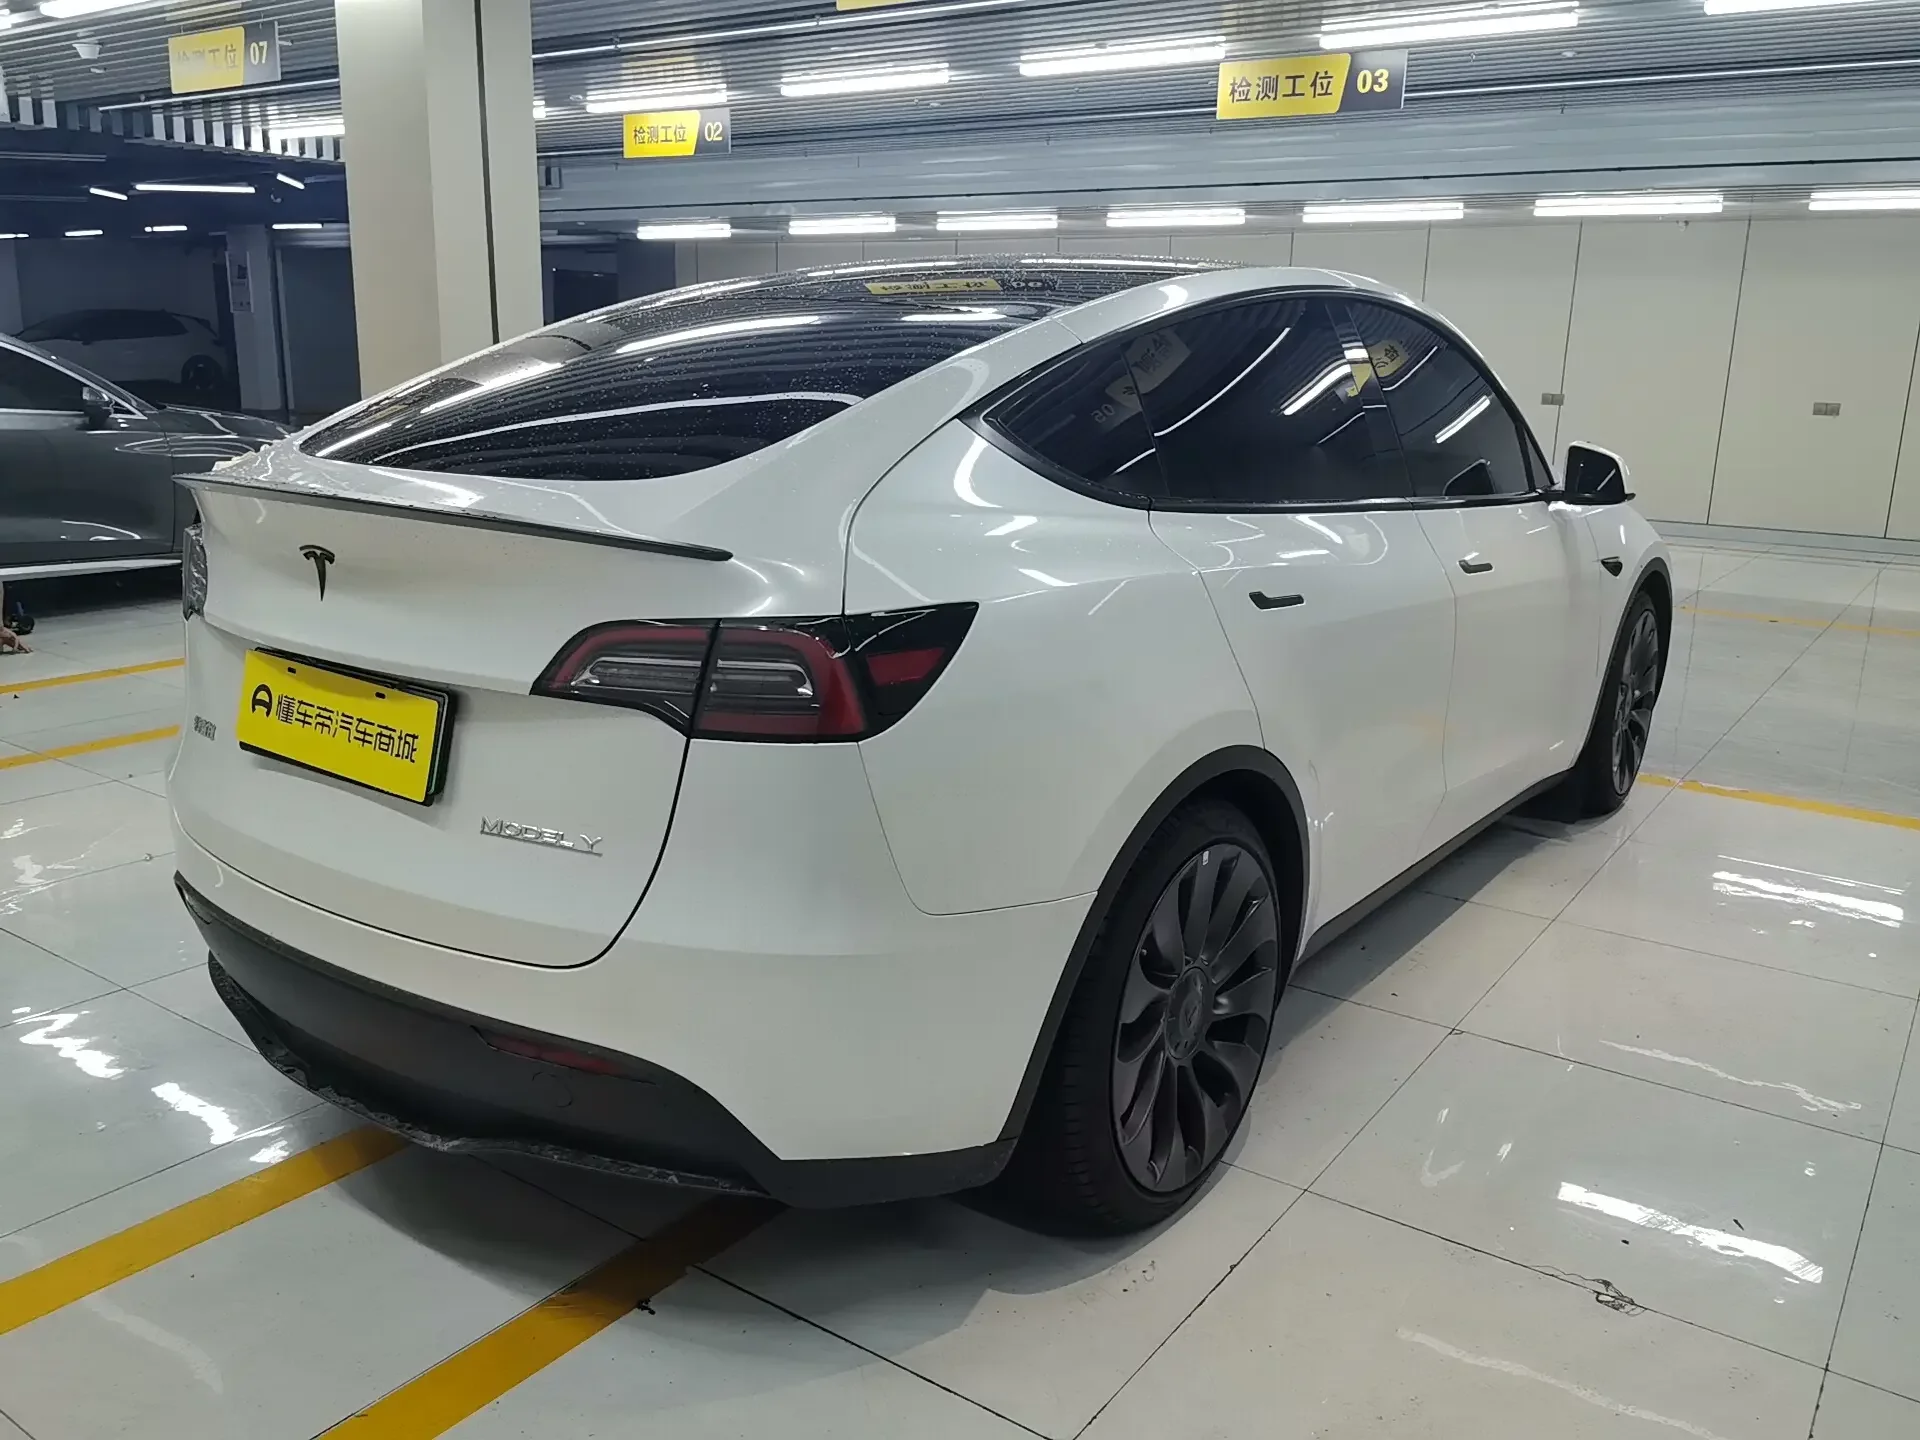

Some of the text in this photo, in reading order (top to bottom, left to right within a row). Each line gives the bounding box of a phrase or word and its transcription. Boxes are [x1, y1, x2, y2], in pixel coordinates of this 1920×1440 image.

[250, 41, 268, 65] 07
[1229, 68, 1389, 103] 检测工位 03
[633, 121, 723, 145] 检测工位 02
[276, 693, 420, 763] 懂车帝汽车商城
[480, 815, 602, 852] MODEL Y
